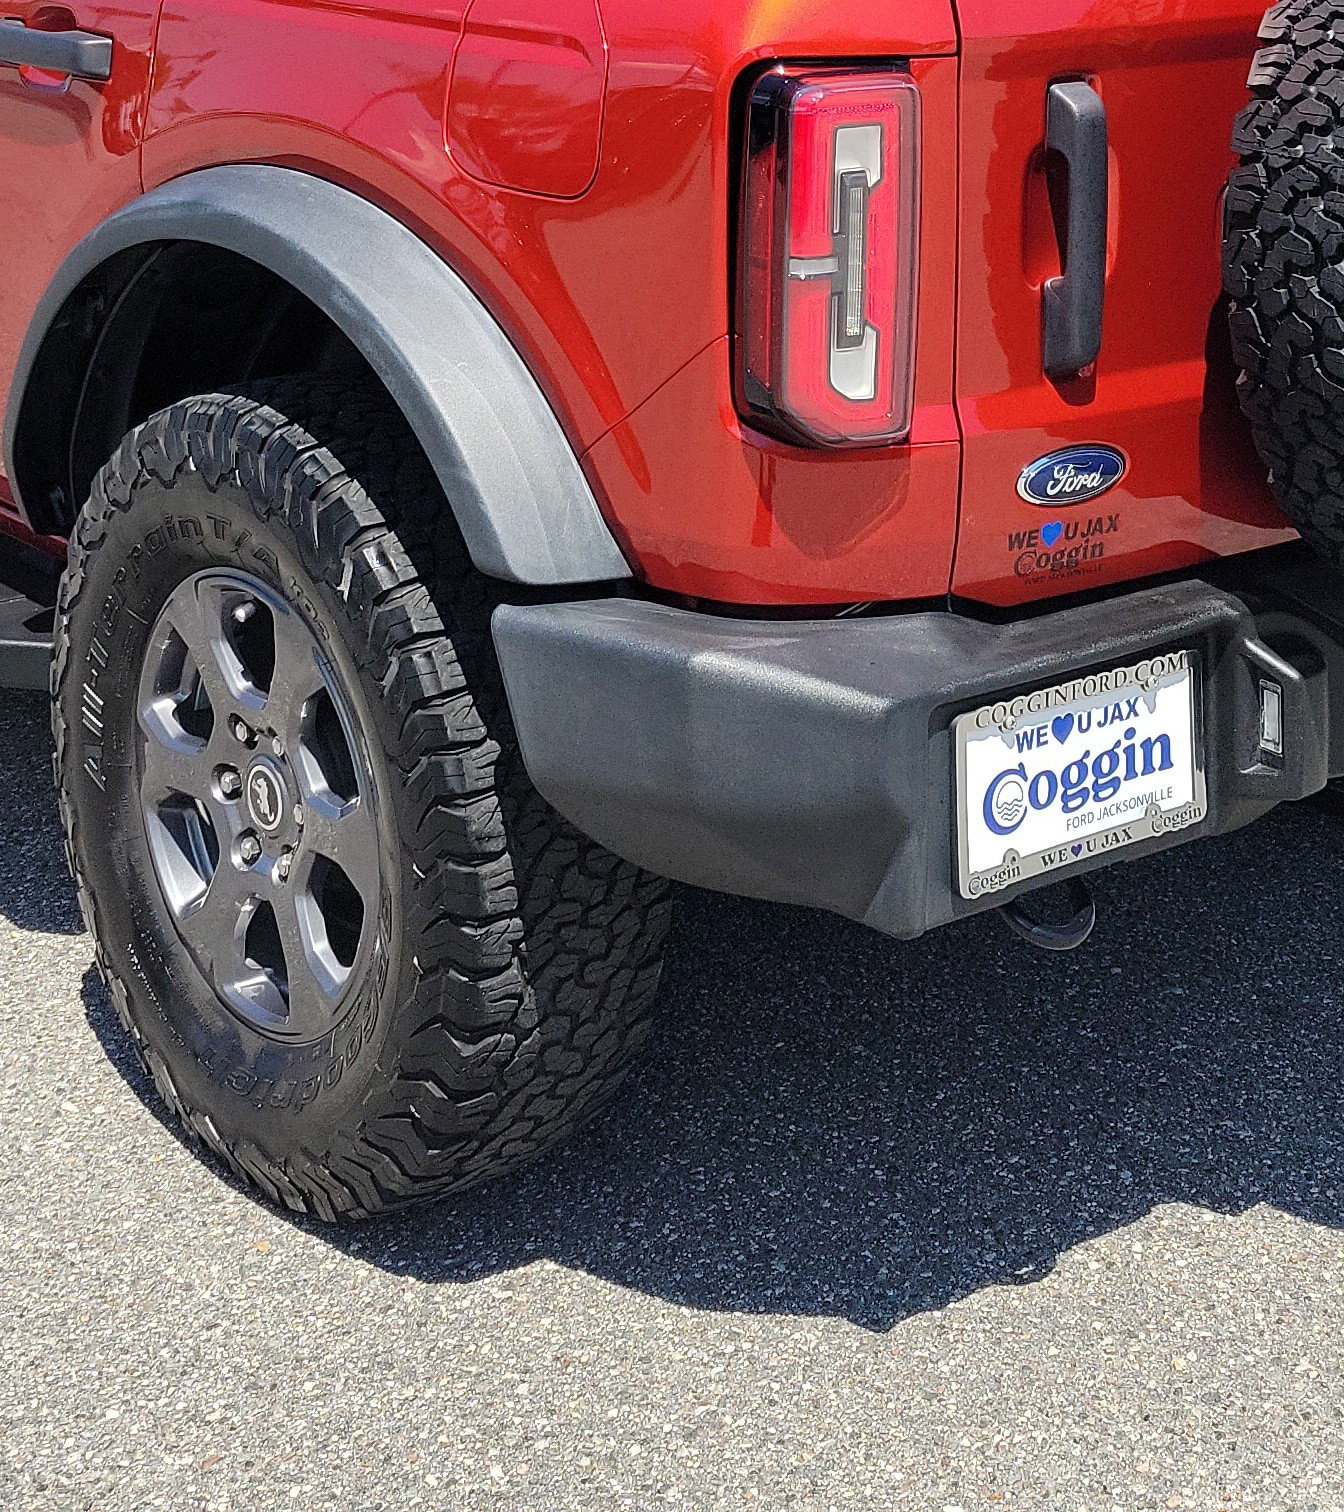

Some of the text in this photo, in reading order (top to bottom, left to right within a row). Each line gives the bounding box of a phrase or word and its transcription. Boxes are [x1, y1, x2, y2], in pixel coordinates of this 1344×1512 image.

[1047, 460, 1104, 496] Ford
[1008, 513, 1120, 551] WE U JAX
[1014, 538, 1104, 578] Coggin
[975, 652, 1186, 729] COGGINFORD.COM
[1015, 697, 1140, 754] WE U JAX
[982, 727, 1175, 836] Coggin
[1066, 786, 1174, 832] FORD JACKSONVILLE
[1151, 804, 1203, 834] Coggin
[1040, 827, 1135, 869] WE U JAX
[968, 863, 1022, 896] Coggin
